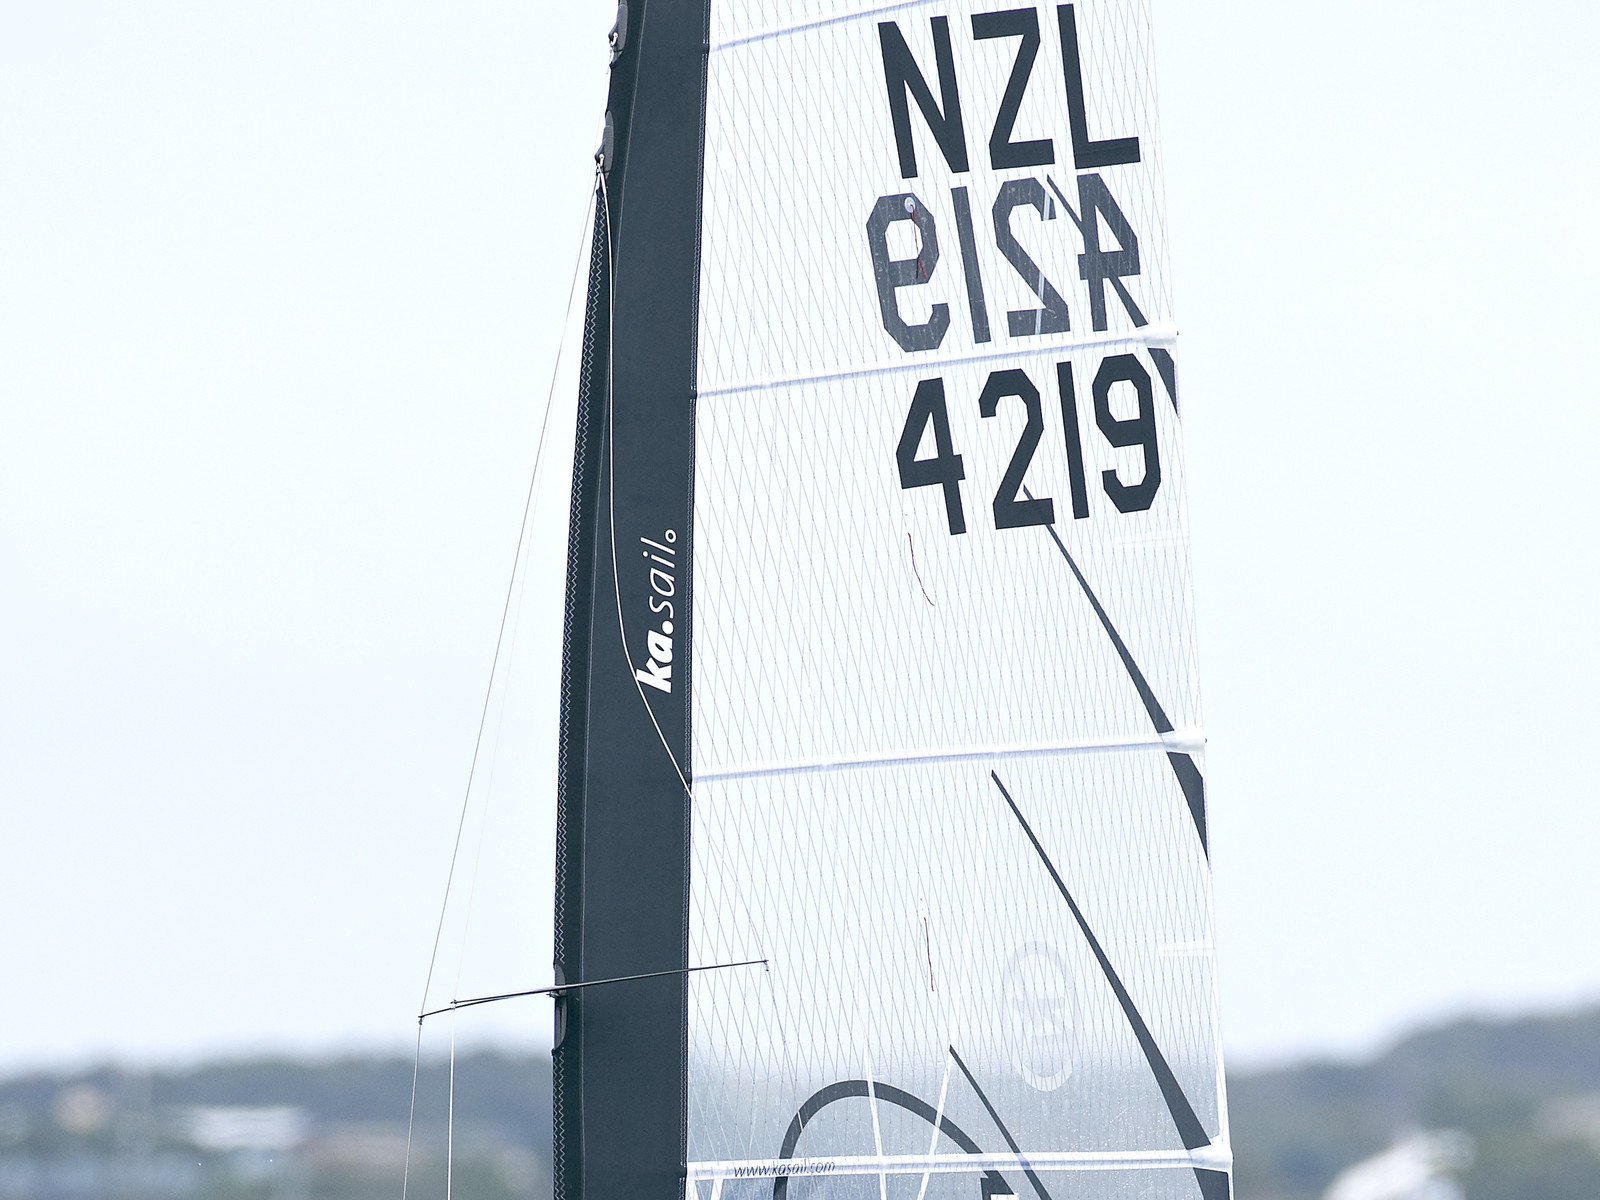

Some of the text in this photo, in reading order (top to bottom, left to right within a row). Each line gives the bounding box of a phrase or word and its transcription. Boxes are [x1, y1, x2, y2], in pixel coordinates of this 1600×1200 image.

[878, 3, 1141, 179] NZL
[896, 353, 1162, 536] 4219
[734, 1158, 836, 1178] www.kasail.com
